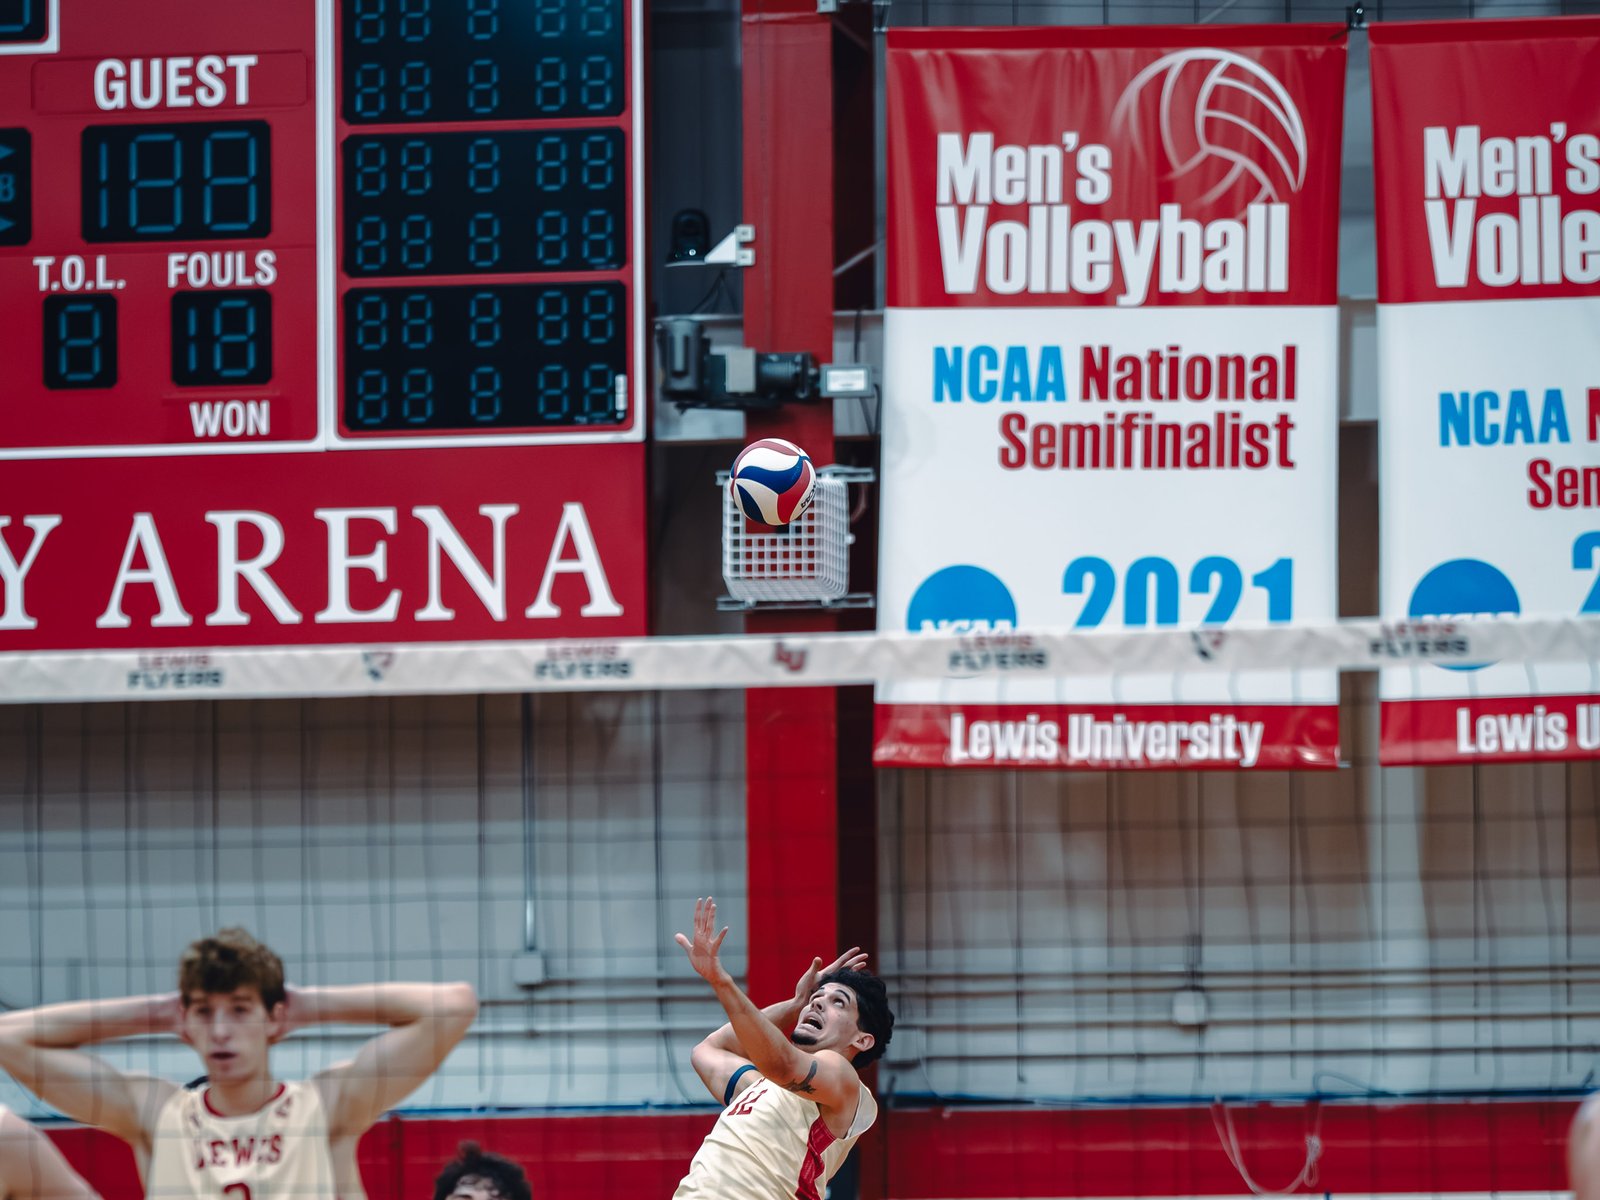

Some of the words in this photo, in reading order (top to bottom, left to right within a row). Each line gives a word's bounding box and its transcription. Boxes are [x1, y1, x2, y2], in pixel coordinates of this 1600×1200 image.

[94, 55, 258, 110] GUEST
[937, 132, 1112, 205] Men's
[1423, 122, 1600, 198] Men's
[167, 250, 277, 288] FOULS
[936, 203, 1289, 306] Volleyball
[1424, 195, 1600, 288] Volle
[32, 255, 126, 291] T.O.L.
[933, 345, 1066, 403] NCAA
[1080, 344, 1297, 402] National
[189, 400, 270, 437] WON
[1000, 411, 1296, 470] Semifinalist
[1439, 388, 1570, 447] NCAA
[96, 502, 624, 628] ARENA
[1062, 556, 1293, 631] 2021
[950, 712, 1059, 762] Lewis
[1068, 712, 1264, 768] University
[1456, 704, 1568, 754] Lewis
